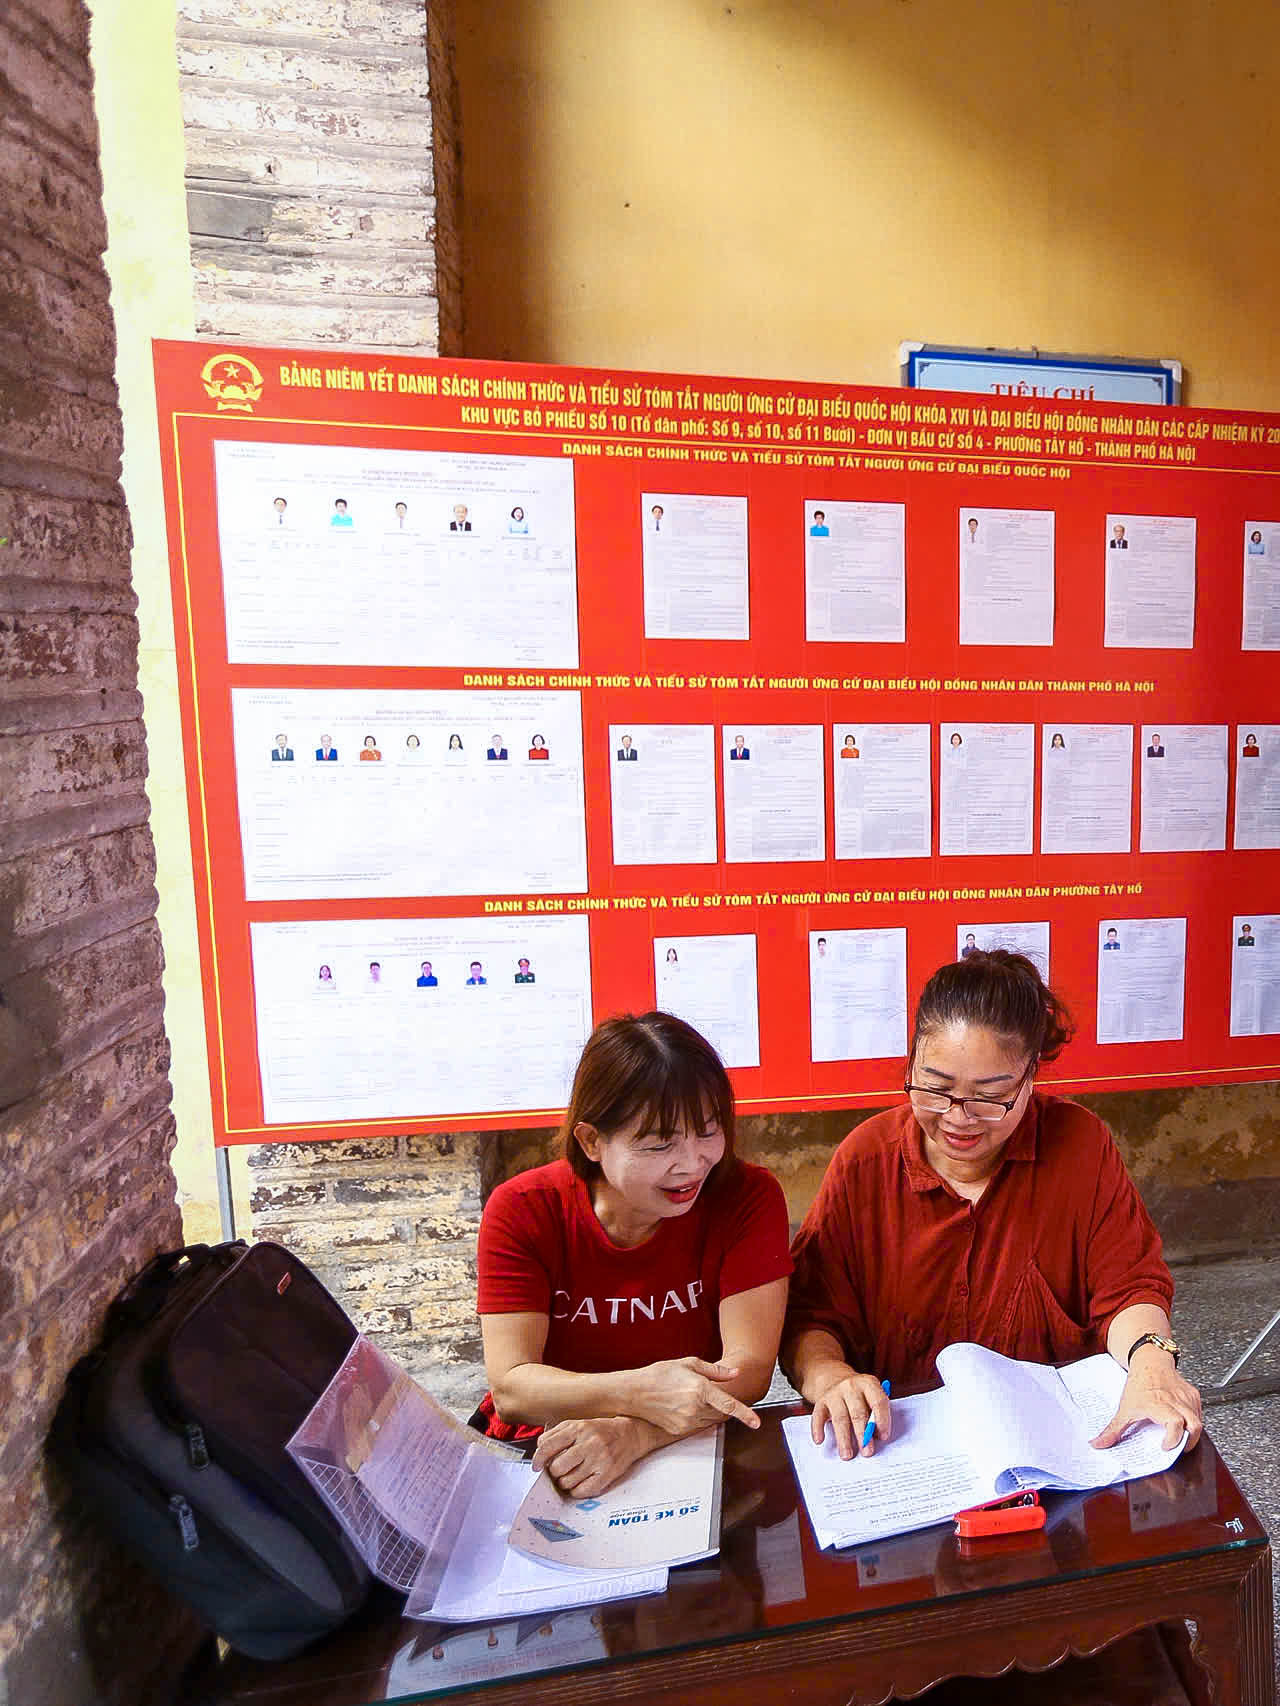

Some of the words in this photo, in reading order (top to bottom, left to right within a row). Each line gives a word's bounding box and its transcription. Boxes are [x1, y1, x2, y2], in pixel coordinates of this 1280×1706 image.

[280, 360, 321, 387] BẢNG
[325, 366, 364, 390] NIÊM
[368, 367, 394, 392] YẾT
[398, 373, 437, 394] DANH
[442, 374, 480, 397] SÁCH
[483, 377, 526, 400] CHÍNH
[530, 380, 565, 402] THỨC
[568, 382, 586, 403] VÀ
[590, 380, 618, 405] TIỂU
[624, 383, 642, 406] SỬ
[644, 386, 672, 408] TÓM
[677, 385, 699, 409] TẮT
[703, 390, 744, 412] NGƯỜI
[747, 392, 772, 413] ỨNG
[776, 392, 794, 415] CỬ
[797, 398, 818, 420] ĐẠI
[822, 394, 850, 418] BIỂU
[854, 397, 886, 421] QUỐC
[890, 401, 910, 425] HỘI
[914, 403, 946, 424] KHÓA
[950, 408, 968, 425] XVI
[972, 406, 988, 426] VÀ
[991, 410, 1010, 431] ĐẠI
[1014, 407, 1040, 429] BIỂU
[1044, 411, 1063, 434] HỘI
[462, 406, 488, 423] KHU
[493, 408, 519, 428] VỰC
[523, 406, 541, 426] BỎ
[545, 408, 585, 428] PHIẾU
[590, 410, 606, 429] SỐ
[611, 415, 626, 431] 10
[654, 417, 677, 433] dân
[681, 418, 708, 436] phố:
[712, 419, 728, 436] Số
[732, 421, 743, 438] 9,
[747, 420, 762, 438] số
[765, 424, 784, 440] 10,
[788, 423, 801, 440] số
[806, 425, 819, 440] 11
[868, 428, 892, 444] ĐƠN
[896, 430, 907, 449] VỊ
[938, 429, 954, 448] CỬ
[957, 431, 972, 449] SỐ
[976, 435, 983, 449] 4
[994, 433, 1041, 452] PHƯỜNG
[1095, 440, 1130, 457] THÀNH
[1177, 444, 1196, 463] NỘI
[563, 443, 601, 455] DANH
[464, 675, 502, 685] DANH
[507, 674, 544, 686] SÁCH
[549, 675, 592, 686] CHÍNH
[596, 675, 630, 687] THỨC
[634, 675, 652, 687] VÀ
[655, 674, 684, 687] TIỂU
[769, 677, 808, 688] NGƯỜI
[812, 677, 838, 688] ỨNG
[888, 677, 916, 689] BIỂU
[920, 679, 940, 691] HỘI
[944, 678, 977, 690] ĐỒNG
[981, 680, 1015, 690] NHÂN
[1047, 680, 1085, 691] THÀNH
[1134, 681, 1154, 693] NỘI
[485, 901, 522, 911] DANH
[527, 899, 563, 910] SÁCH
[567, 898, 608, 910] CHÍNH
[613, 896, 647, 908] THỨC
[650, 896, 668, 907] VÀ
[671, 894, 699, 907] TIỂU
[898, 888, 926, 901] BIỂU
[929, 889, 950, 902] HỘI
